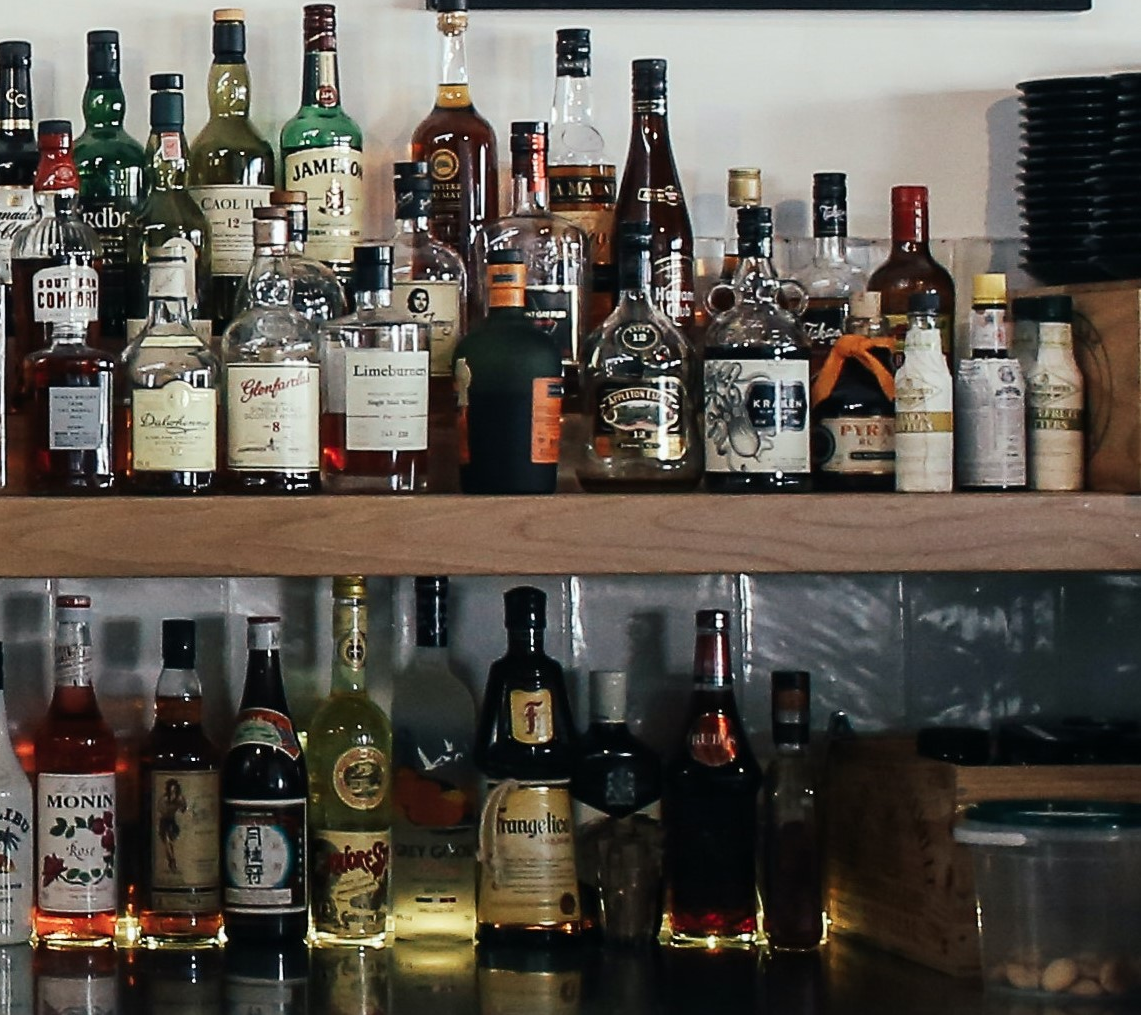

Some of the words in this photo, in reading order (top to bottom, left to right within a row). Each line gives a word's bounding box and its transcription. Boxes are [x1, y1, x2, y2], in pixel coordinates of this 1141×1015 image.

[201, 197, 240, 210] CAOL
[226, 218, 240, 229] 12
[272, 420, 281, 432] 8
[47, 795, 113, 809] MONIN
